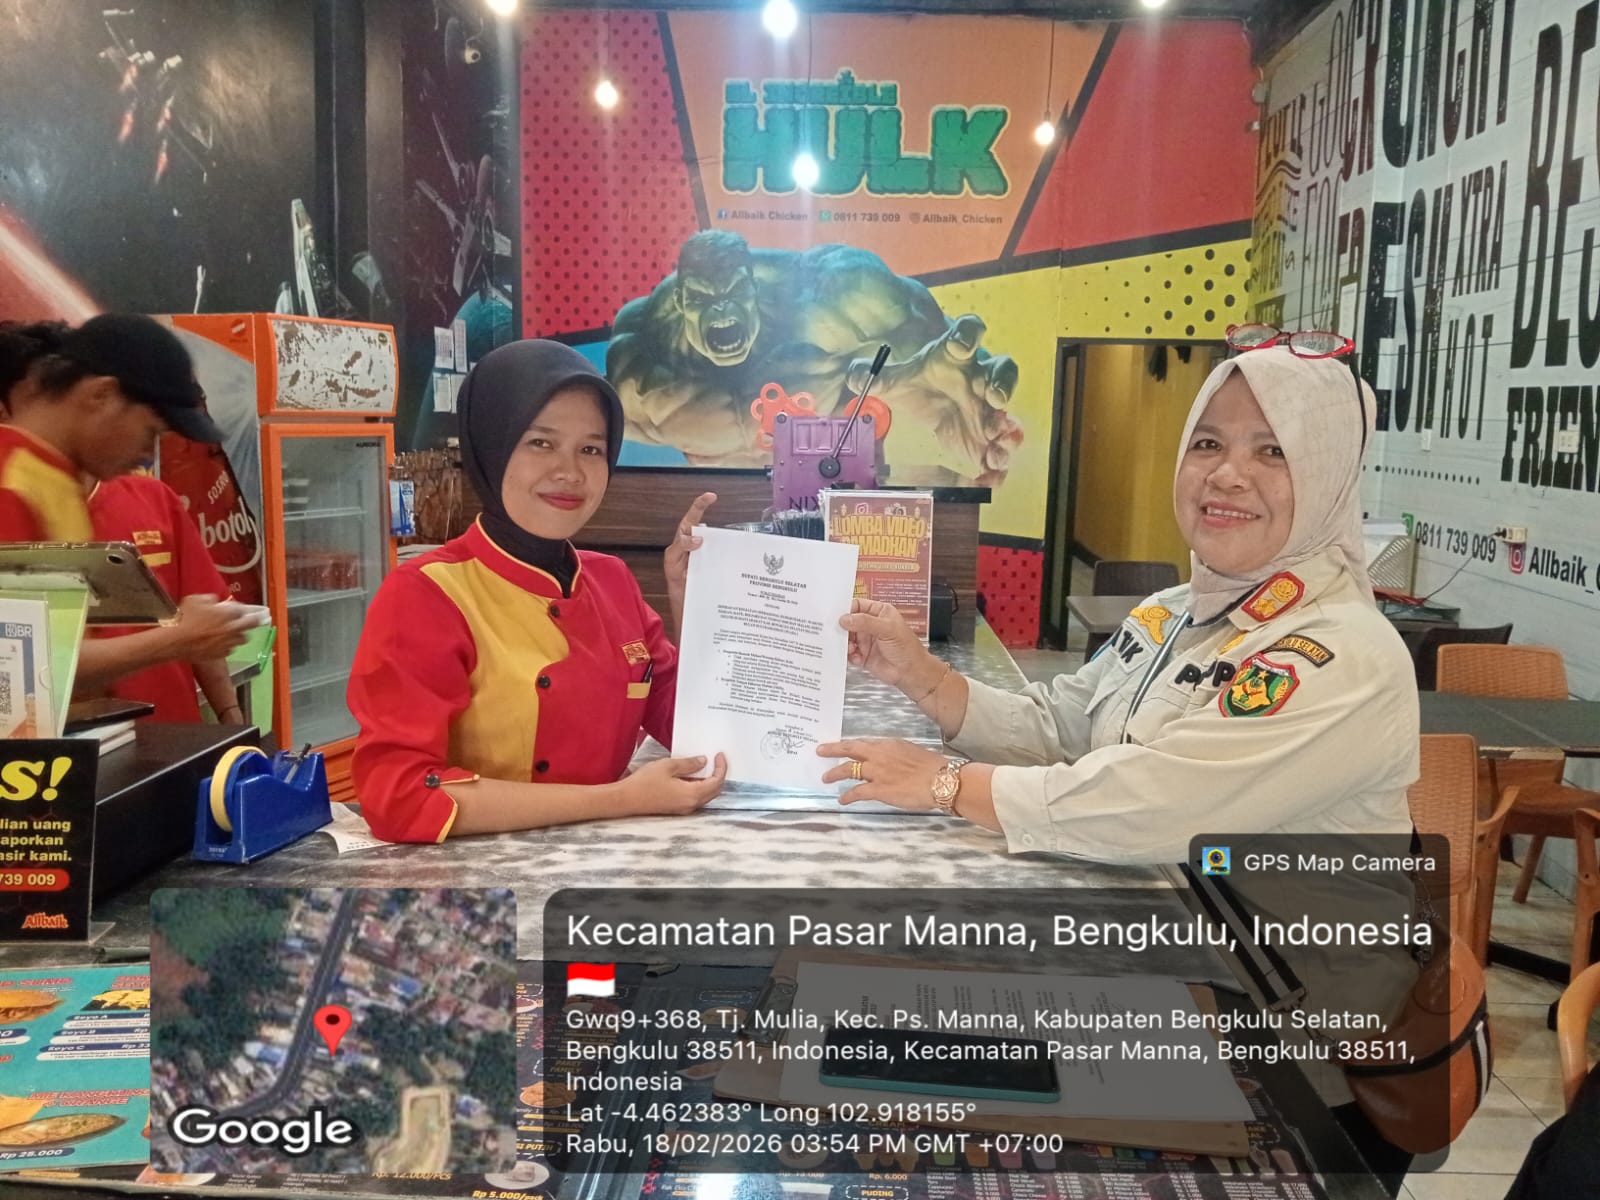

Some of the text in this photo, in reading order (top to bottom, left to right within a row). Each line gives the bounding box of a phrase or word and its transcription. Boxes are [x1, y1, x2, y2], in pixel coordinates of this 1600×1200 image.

[722, 105, 1008, 193] HULK
[768, 211, 808, 221] Chicken
[834, 212, 858, 222] 0811
[881, 213, 900, 223] 009
[923, 213, 1003, 225] Allbaik Chicken
[1452, 160, 1507, 297] XTRA
[1440, 313, 1494, 440] HOT
[198, 495, 253, 549] botol
[833, 515, 926, 538] LOMBA VIDEO
[1415, 521, 1600, 594] 0811 739 009 Allbaik_
[33, 820, 71, 832] uang
[30, 850, 72, 861] kami.
[28, 873, 56, 886] 009
[472, 1190, 487, 1200] Rp
[861, 1189, 894, 1197] PUDING
